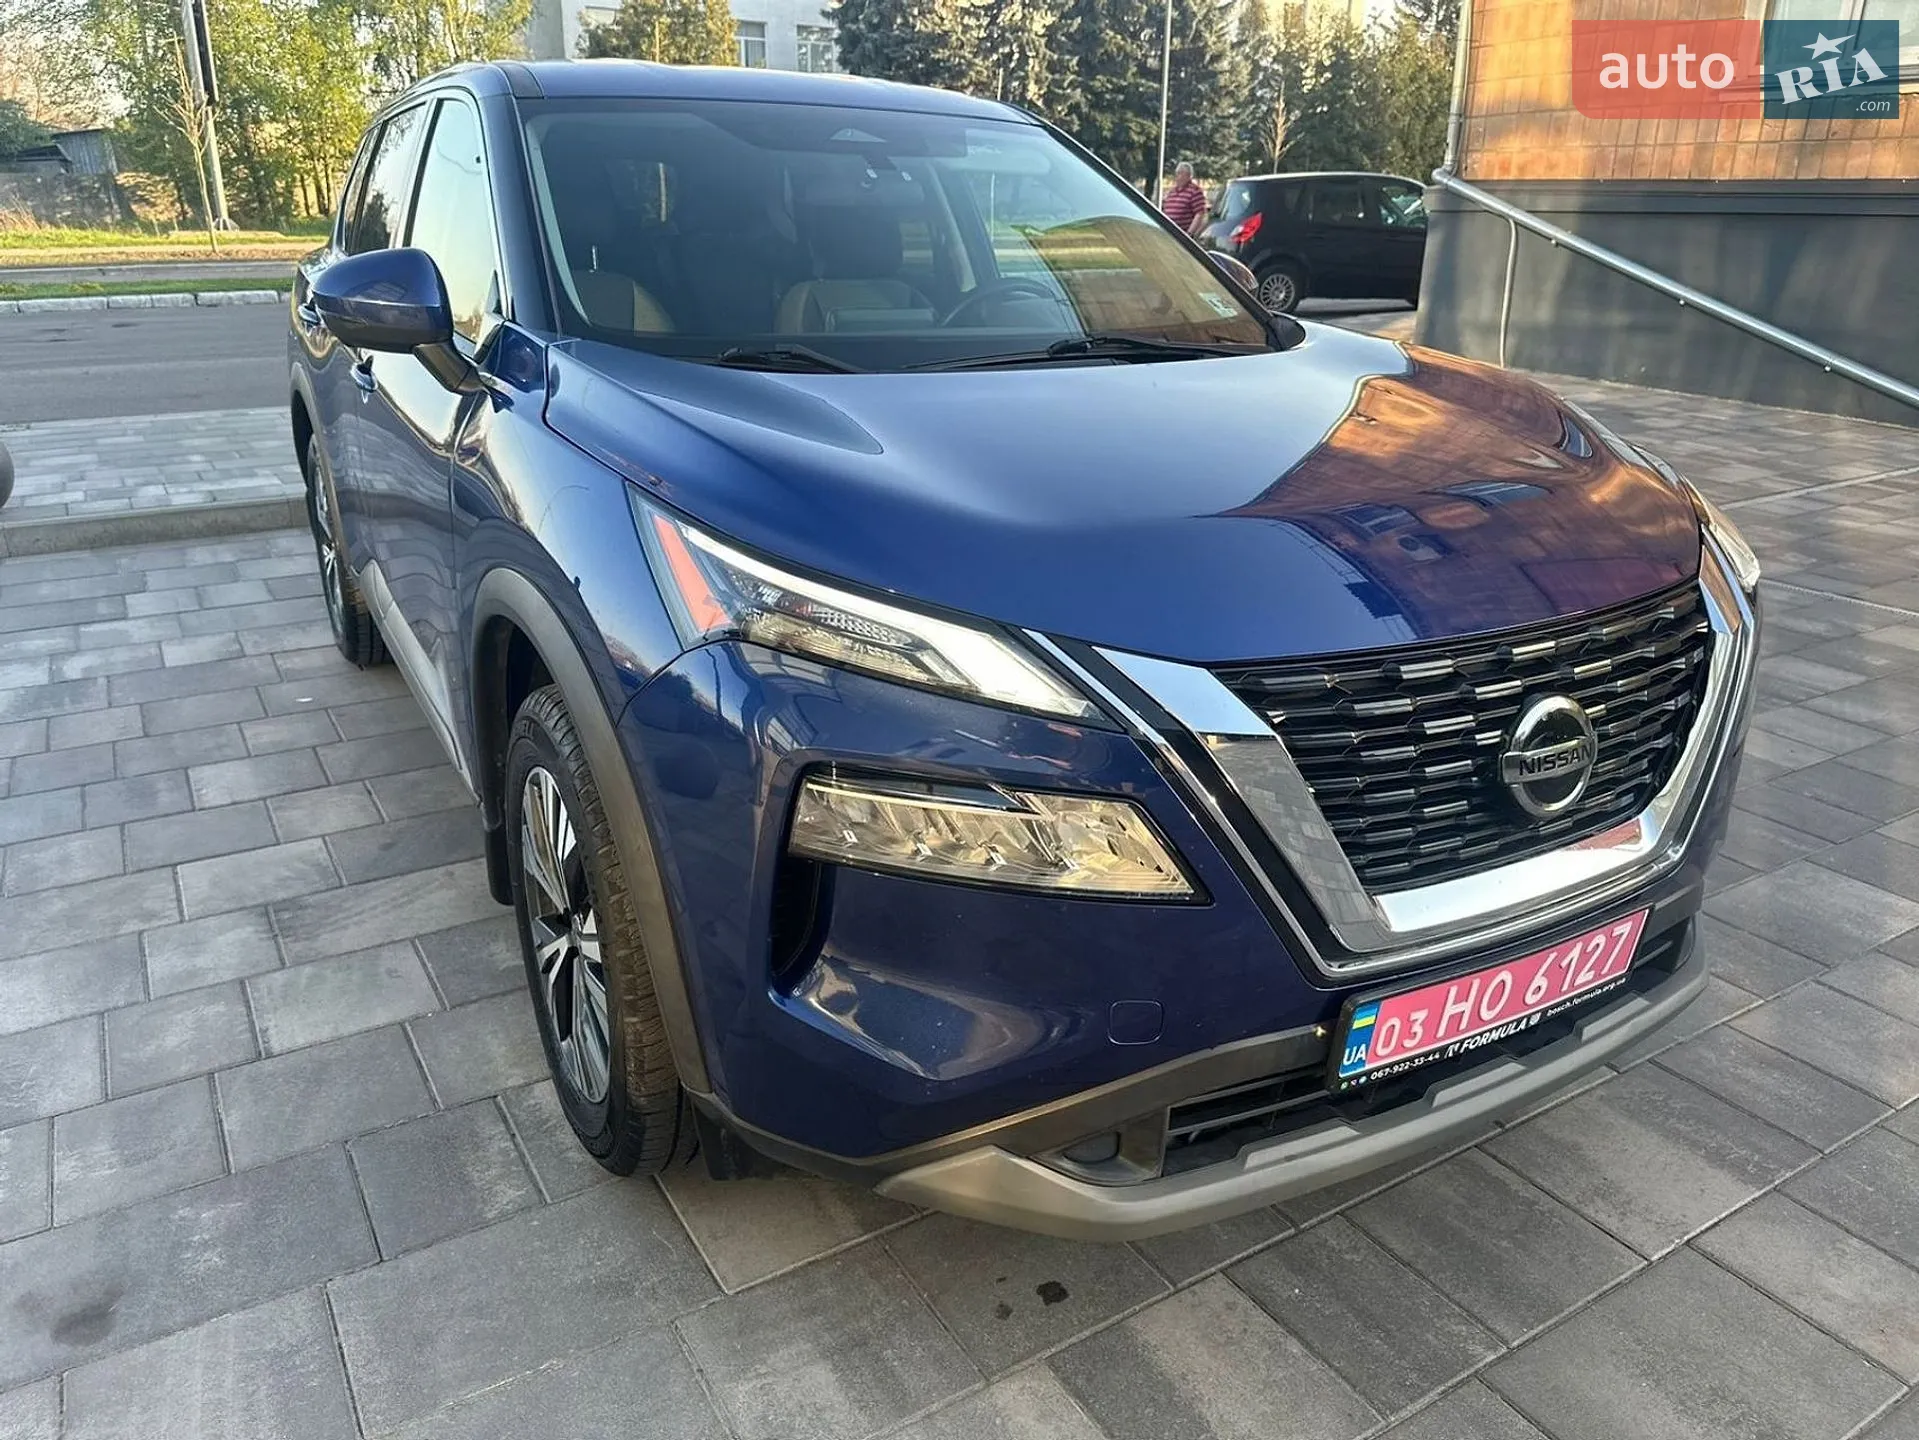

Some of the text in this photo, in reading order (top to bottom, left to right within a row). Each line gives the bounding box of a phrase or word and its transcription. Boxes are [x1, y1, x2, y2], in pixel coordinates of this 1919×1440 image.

[1519, 745, 1592, 776] NISSAN
[1376, 920, 1633, 1057] 03 HO 6127
[1460, 1018, 1527, 1053] FORMULA
[1342, 1043, 1367, 1066] UA
